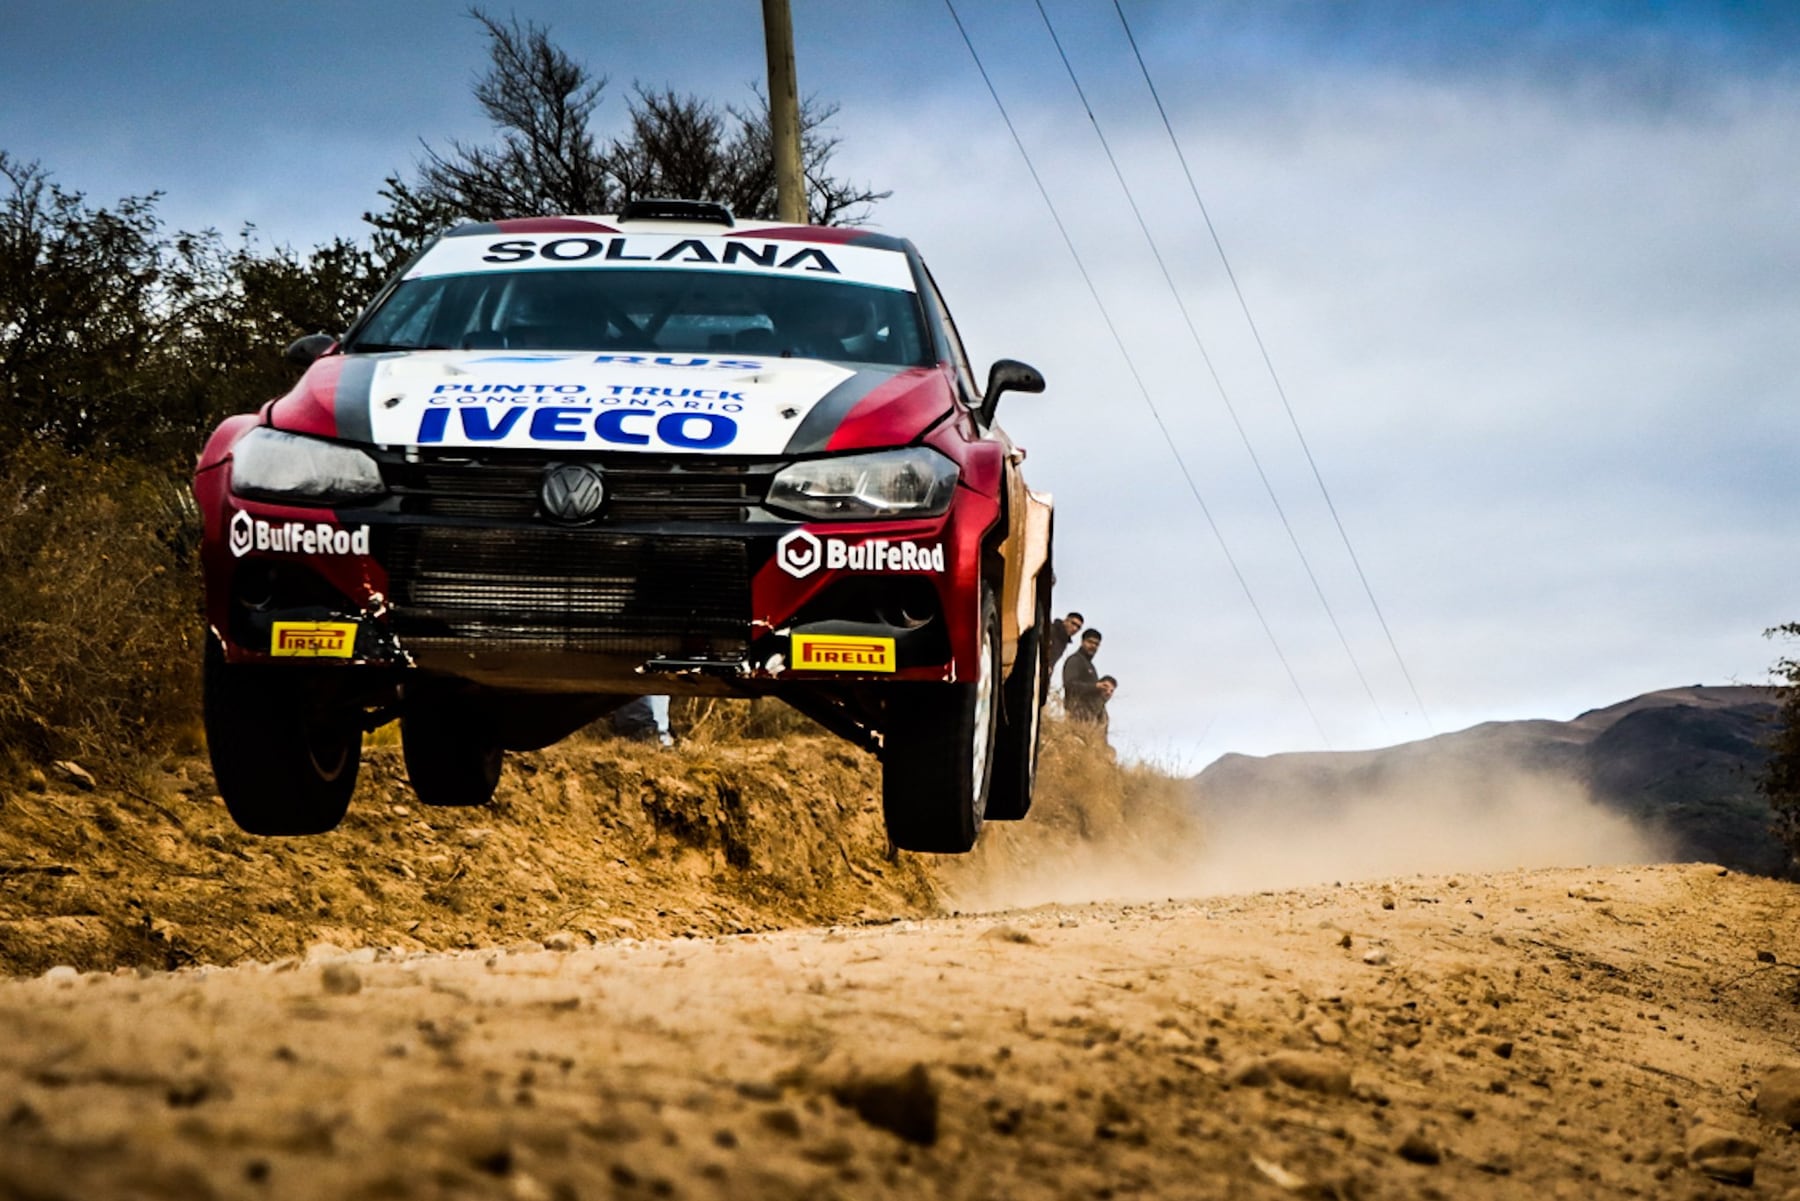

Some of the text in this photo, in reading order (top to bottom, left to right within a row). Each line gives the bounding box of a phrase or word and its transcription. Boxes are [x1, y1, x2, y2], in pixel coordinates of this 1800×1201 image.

[482, 238, 841, 274] SOLANA
[594, 355, 763, 369] RUS
[428, 396, 743, 412] CONCESIONARIO
[433, 385, 747, 401] PUNTO TRUCK
[417, 407, 738, 449] IVECO
[255, 520, 370, 555] BulFeRod
[827, 539, 945, 572] BulFeRod
[803, 643, 885, 664] PIRELLI
